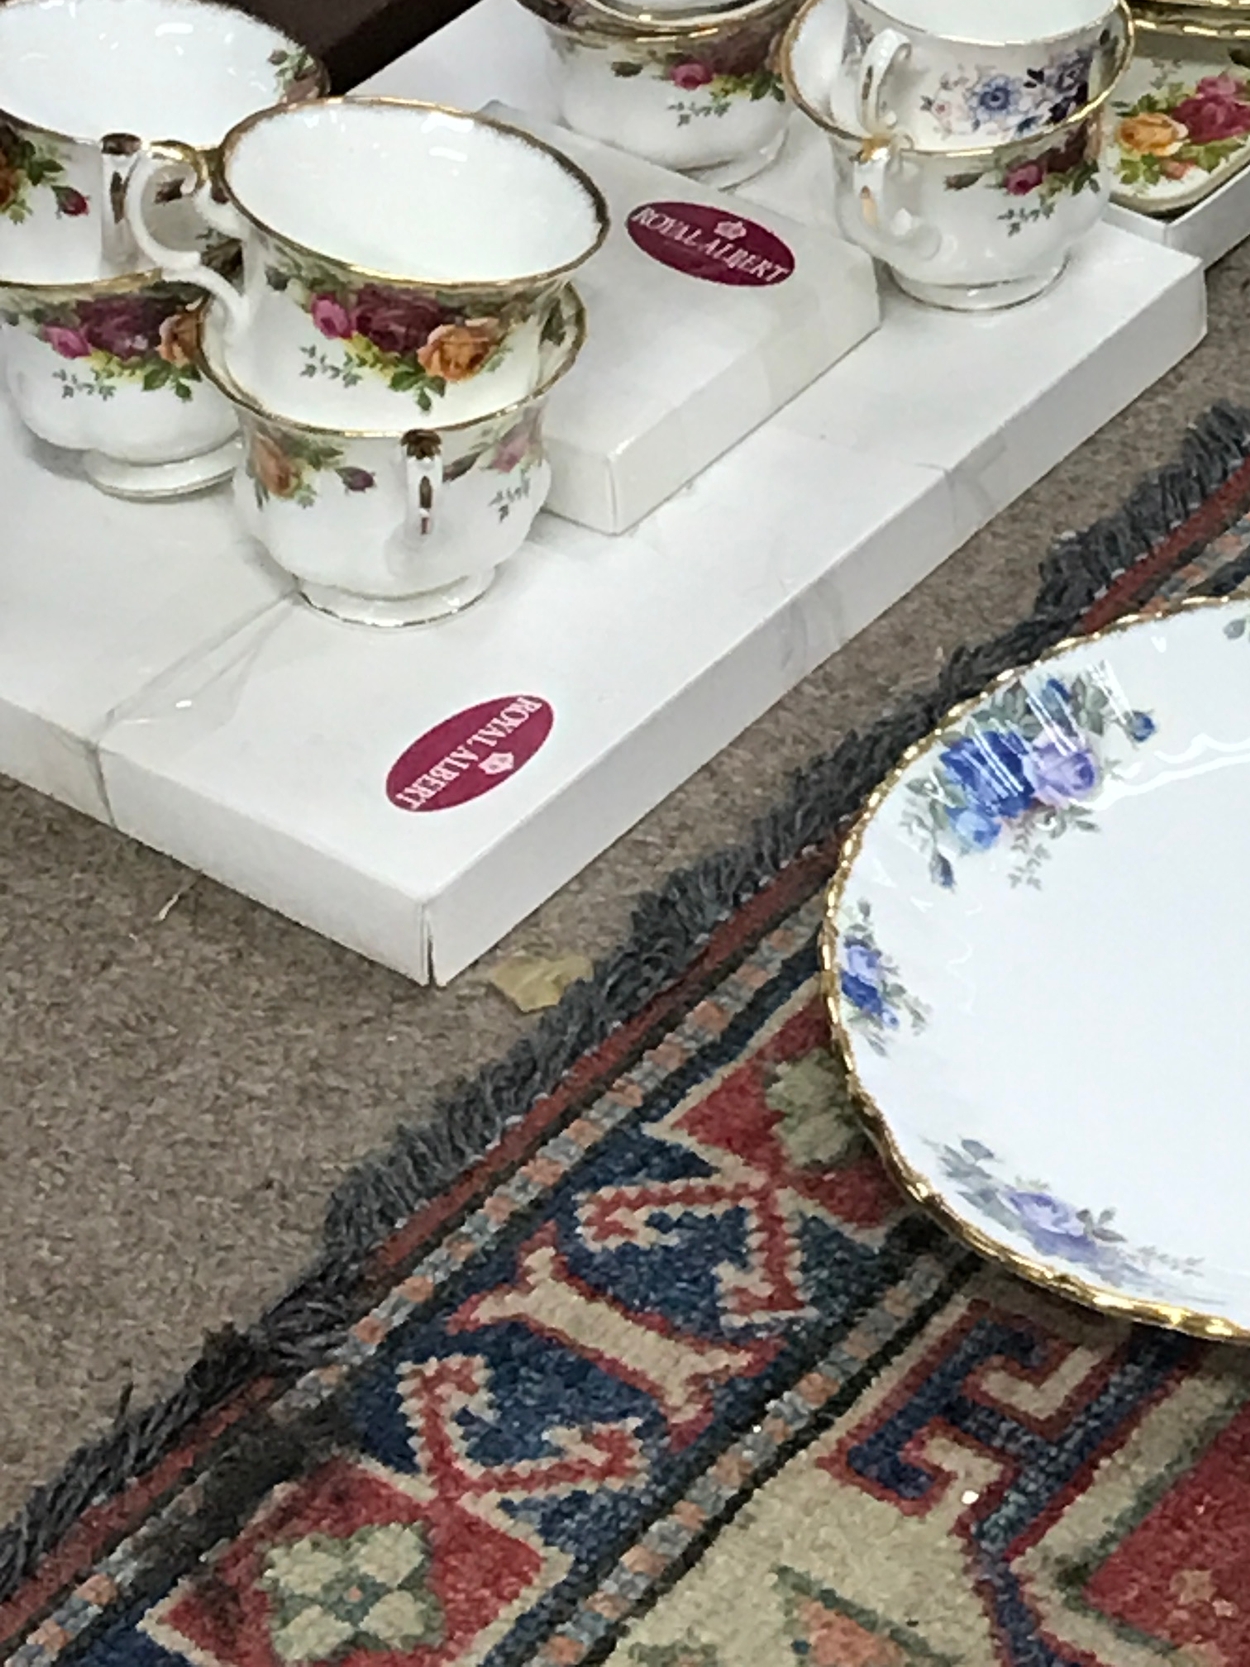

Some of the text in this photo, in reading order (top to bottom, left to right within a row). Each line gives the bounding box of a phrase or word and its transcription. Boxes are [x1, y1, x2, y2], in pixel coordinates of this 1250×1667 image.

[631, 206, 789, 282] ROYAL ALBERT
[395, 696, 543, 810] ROYAL ALBERT
